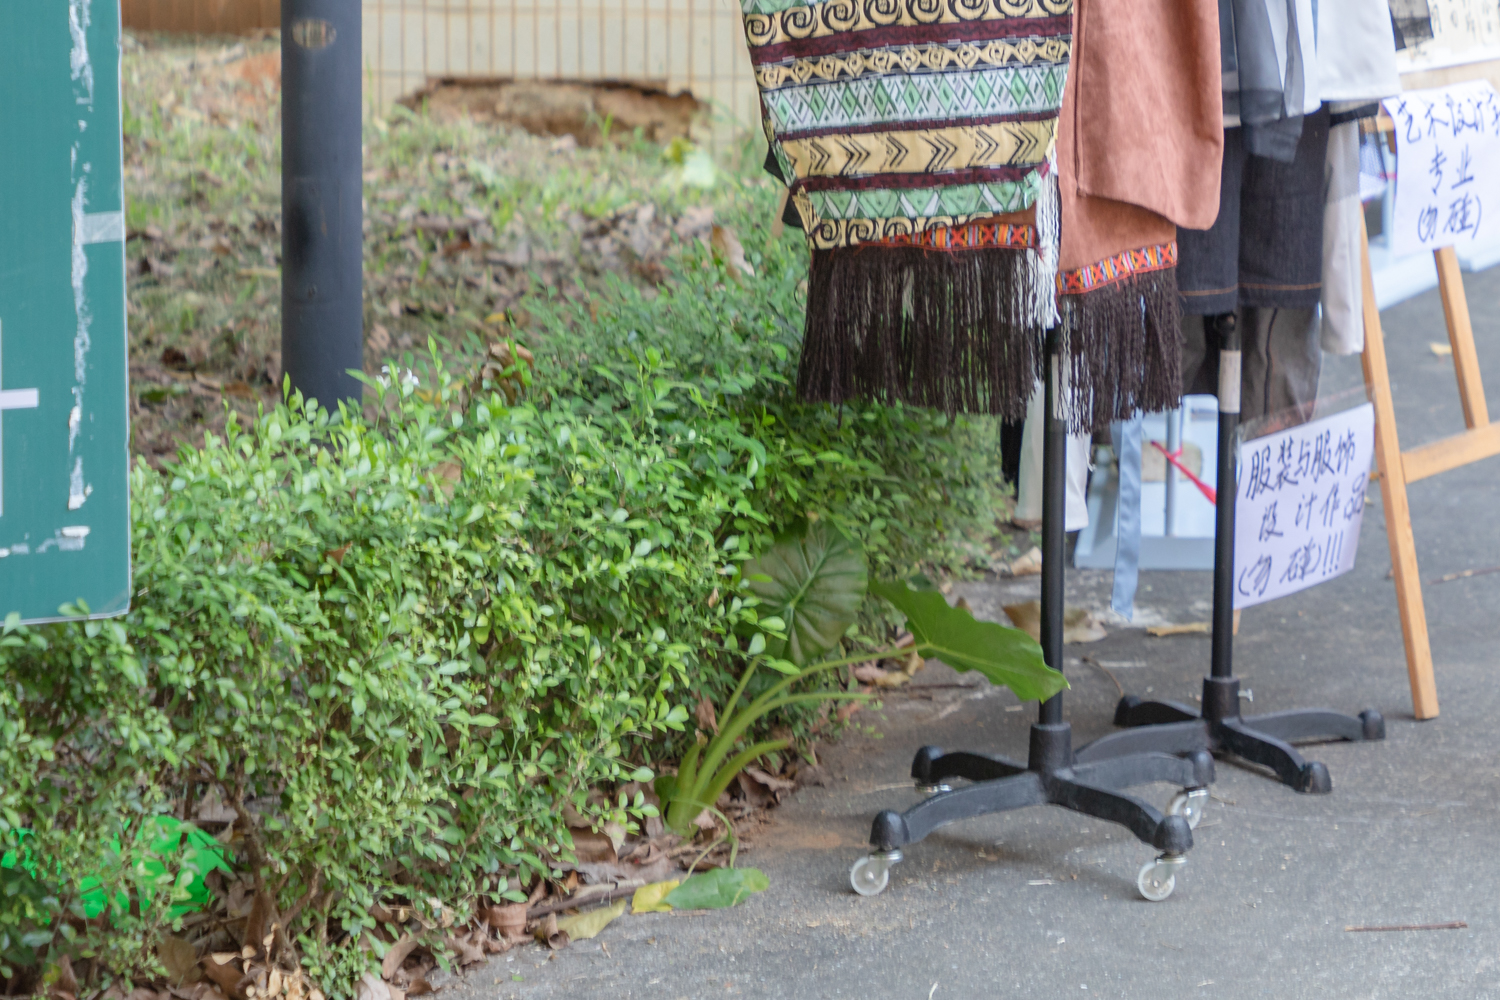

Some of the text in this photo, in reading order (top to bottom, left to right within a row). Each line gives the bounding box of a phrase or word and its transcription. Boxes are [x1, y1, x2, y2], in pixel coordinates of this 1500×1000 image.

[1429, 142, 1475, 197] 专业
[1246, 426, 1356, 500] 服装与服饰
[1259, 471, 1367, 542] 设计作品
